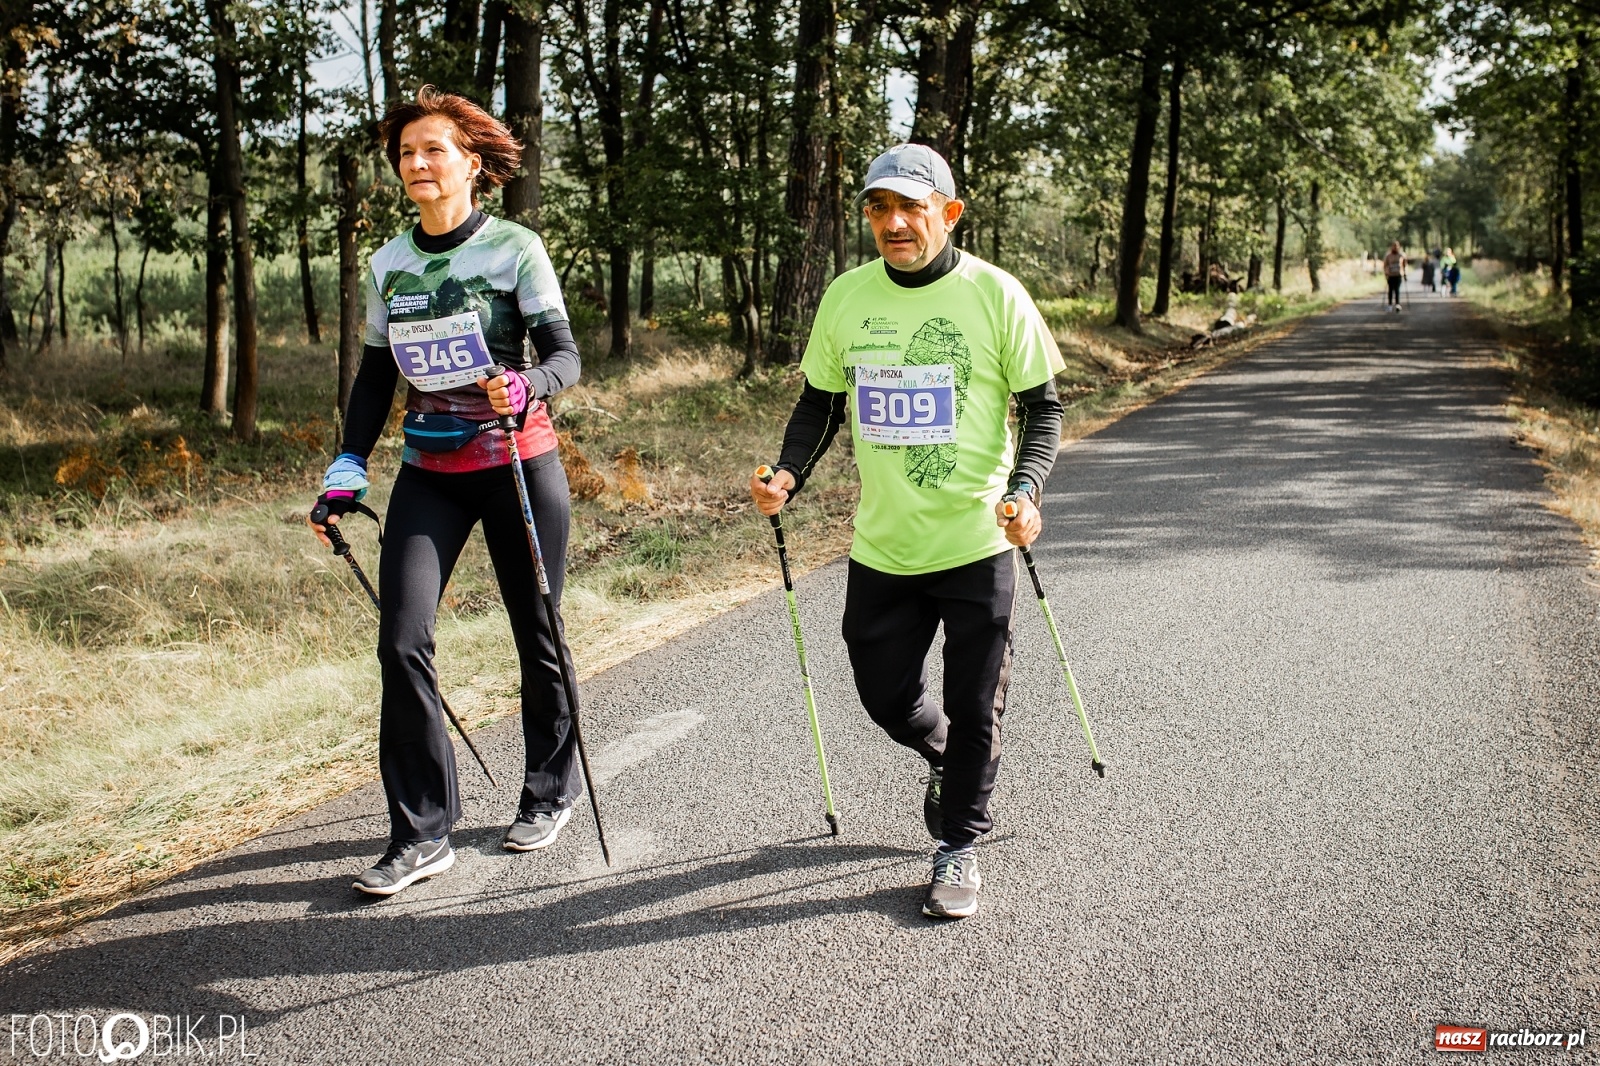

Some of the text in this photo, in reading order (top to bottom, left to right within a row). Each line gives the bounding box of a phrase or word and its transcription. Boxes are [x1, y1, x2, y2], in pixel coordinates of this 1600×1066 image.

[411, 324, 434, 334] DYSZKA
[405, 340, 474, 375] 346
[880, 369, 903, 378] DYSZKA
[898, 380, 902, 388] Z
[868, 391, 937, 425] 309
